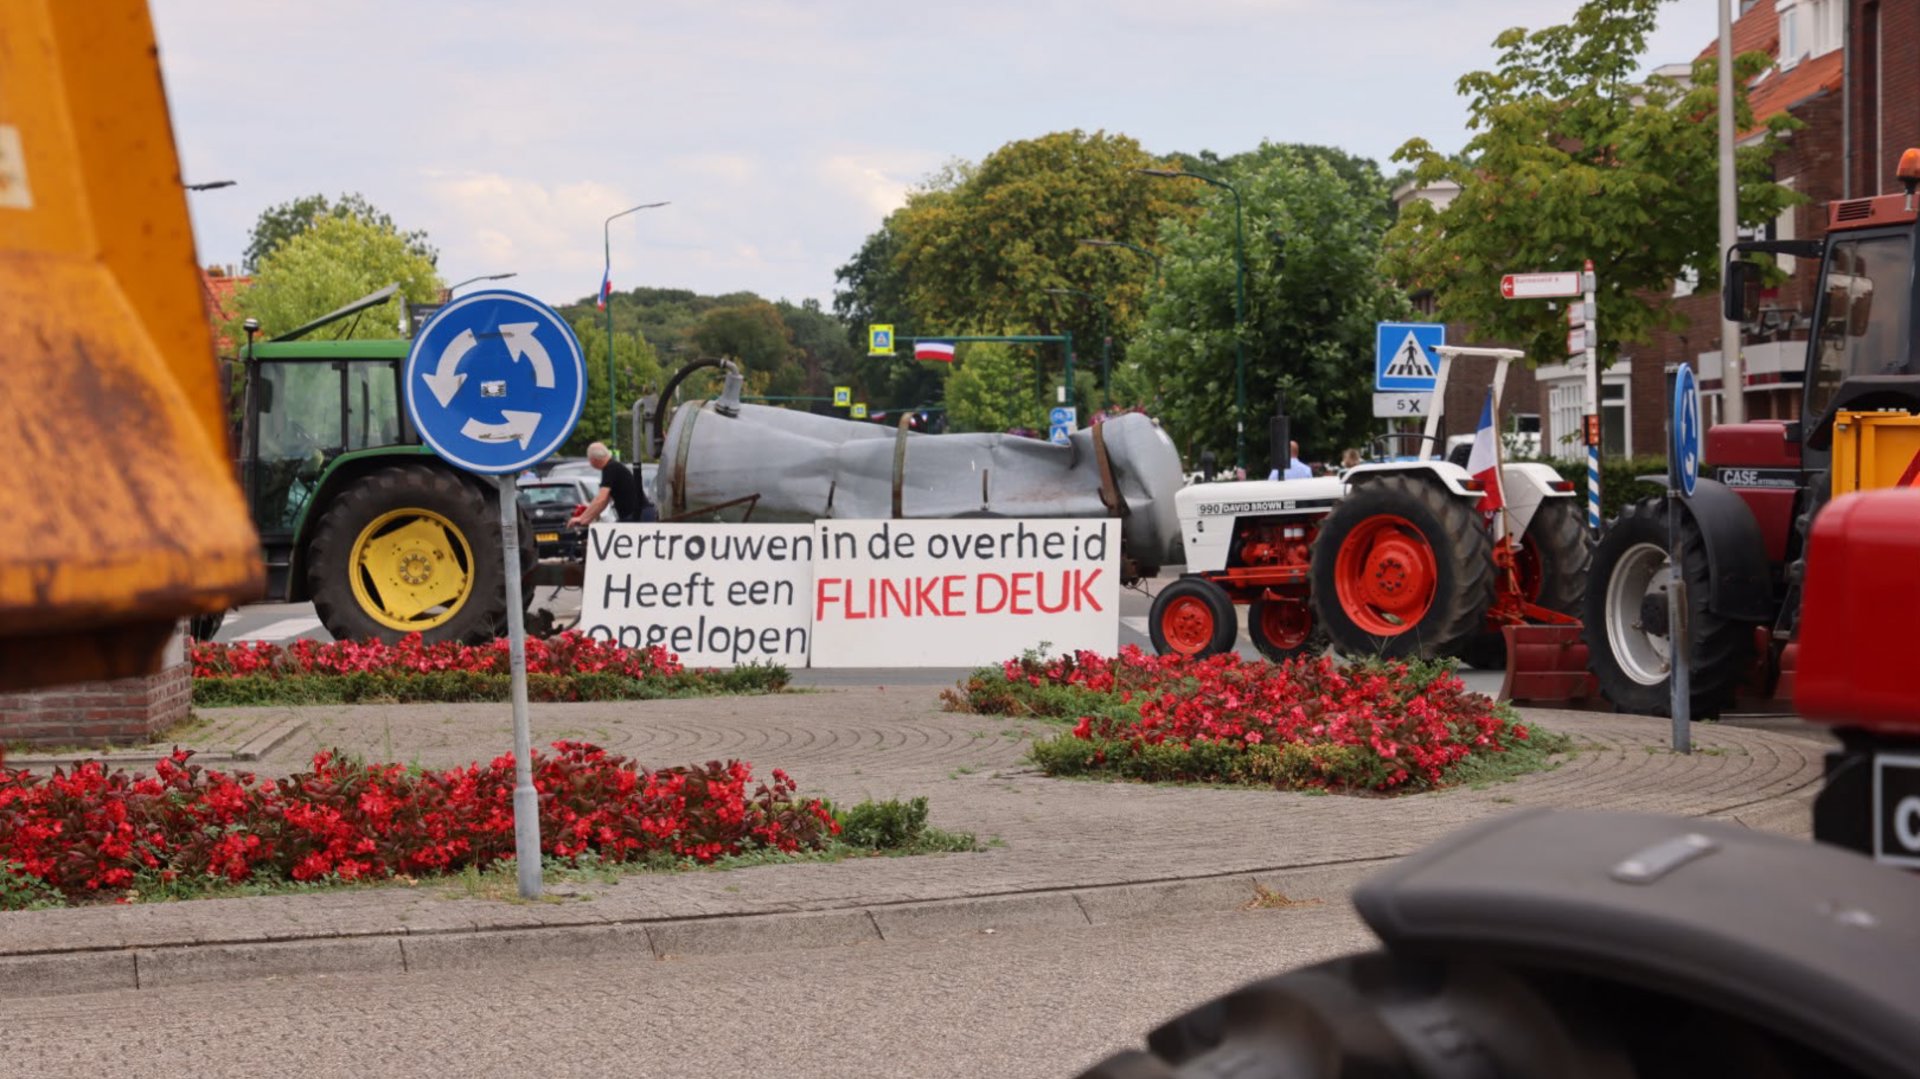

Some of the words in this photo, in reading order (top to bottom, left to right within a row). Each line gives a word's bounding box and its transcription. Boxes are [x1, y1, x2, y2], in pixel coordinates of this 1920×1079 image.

[1397, 399, 1406, 410] 5
[1723, 470, 1758, 485] CASE
[1199, 504, 1220, 514] 990
[1223, 503, 1251, 513] DAVID
[1251, 501, 1282, 511] BROWN
[590, 527, 813, 561] Vertrouwen
[821, 526, 857, 560] in
[867, 522, 915, 560] de
[927, 521, 1107, 561] overheid
[602, 572, 715, 609] Heeft
[727, 579, 794, 606] een
[816, 575, 967, 622] FLINKE
[975, 568, 1103, 615] DEUK
